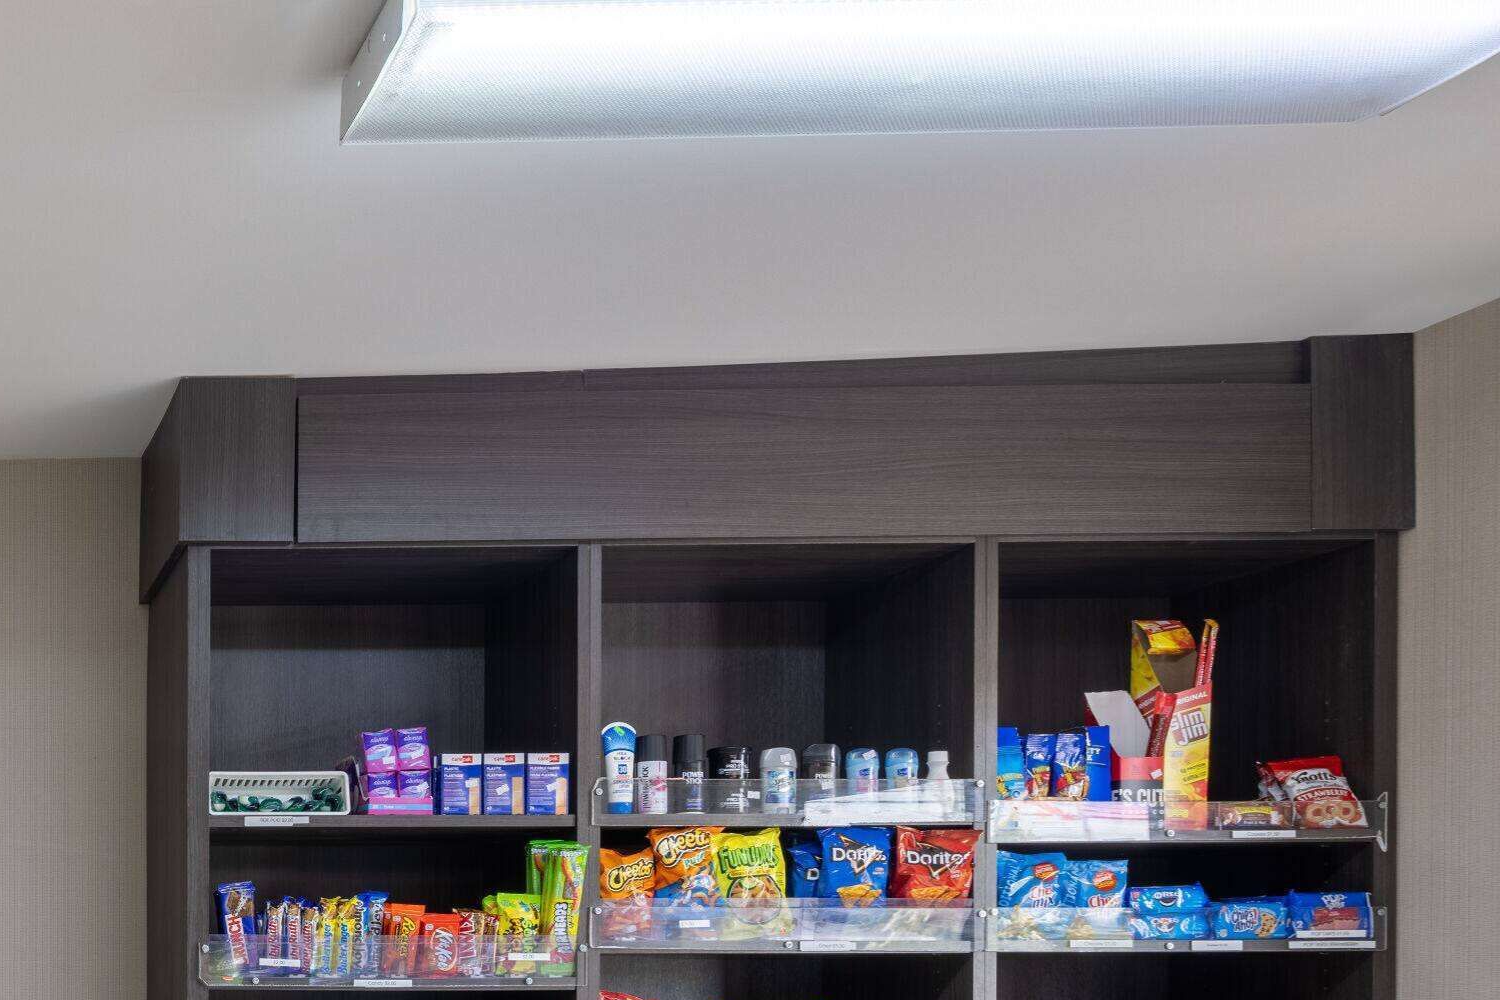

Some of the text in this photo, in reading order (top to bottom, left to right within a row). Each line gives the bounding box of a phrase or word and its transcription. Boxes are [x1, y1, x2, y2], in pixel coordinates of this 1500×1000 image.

[1171, 711, 1205, 731] Slim
[1176, 725, 1209, 746] Jim
[1297, 788, 1349, 802] STRAWBERRY
[906, 850, 971, 866] Doritos
